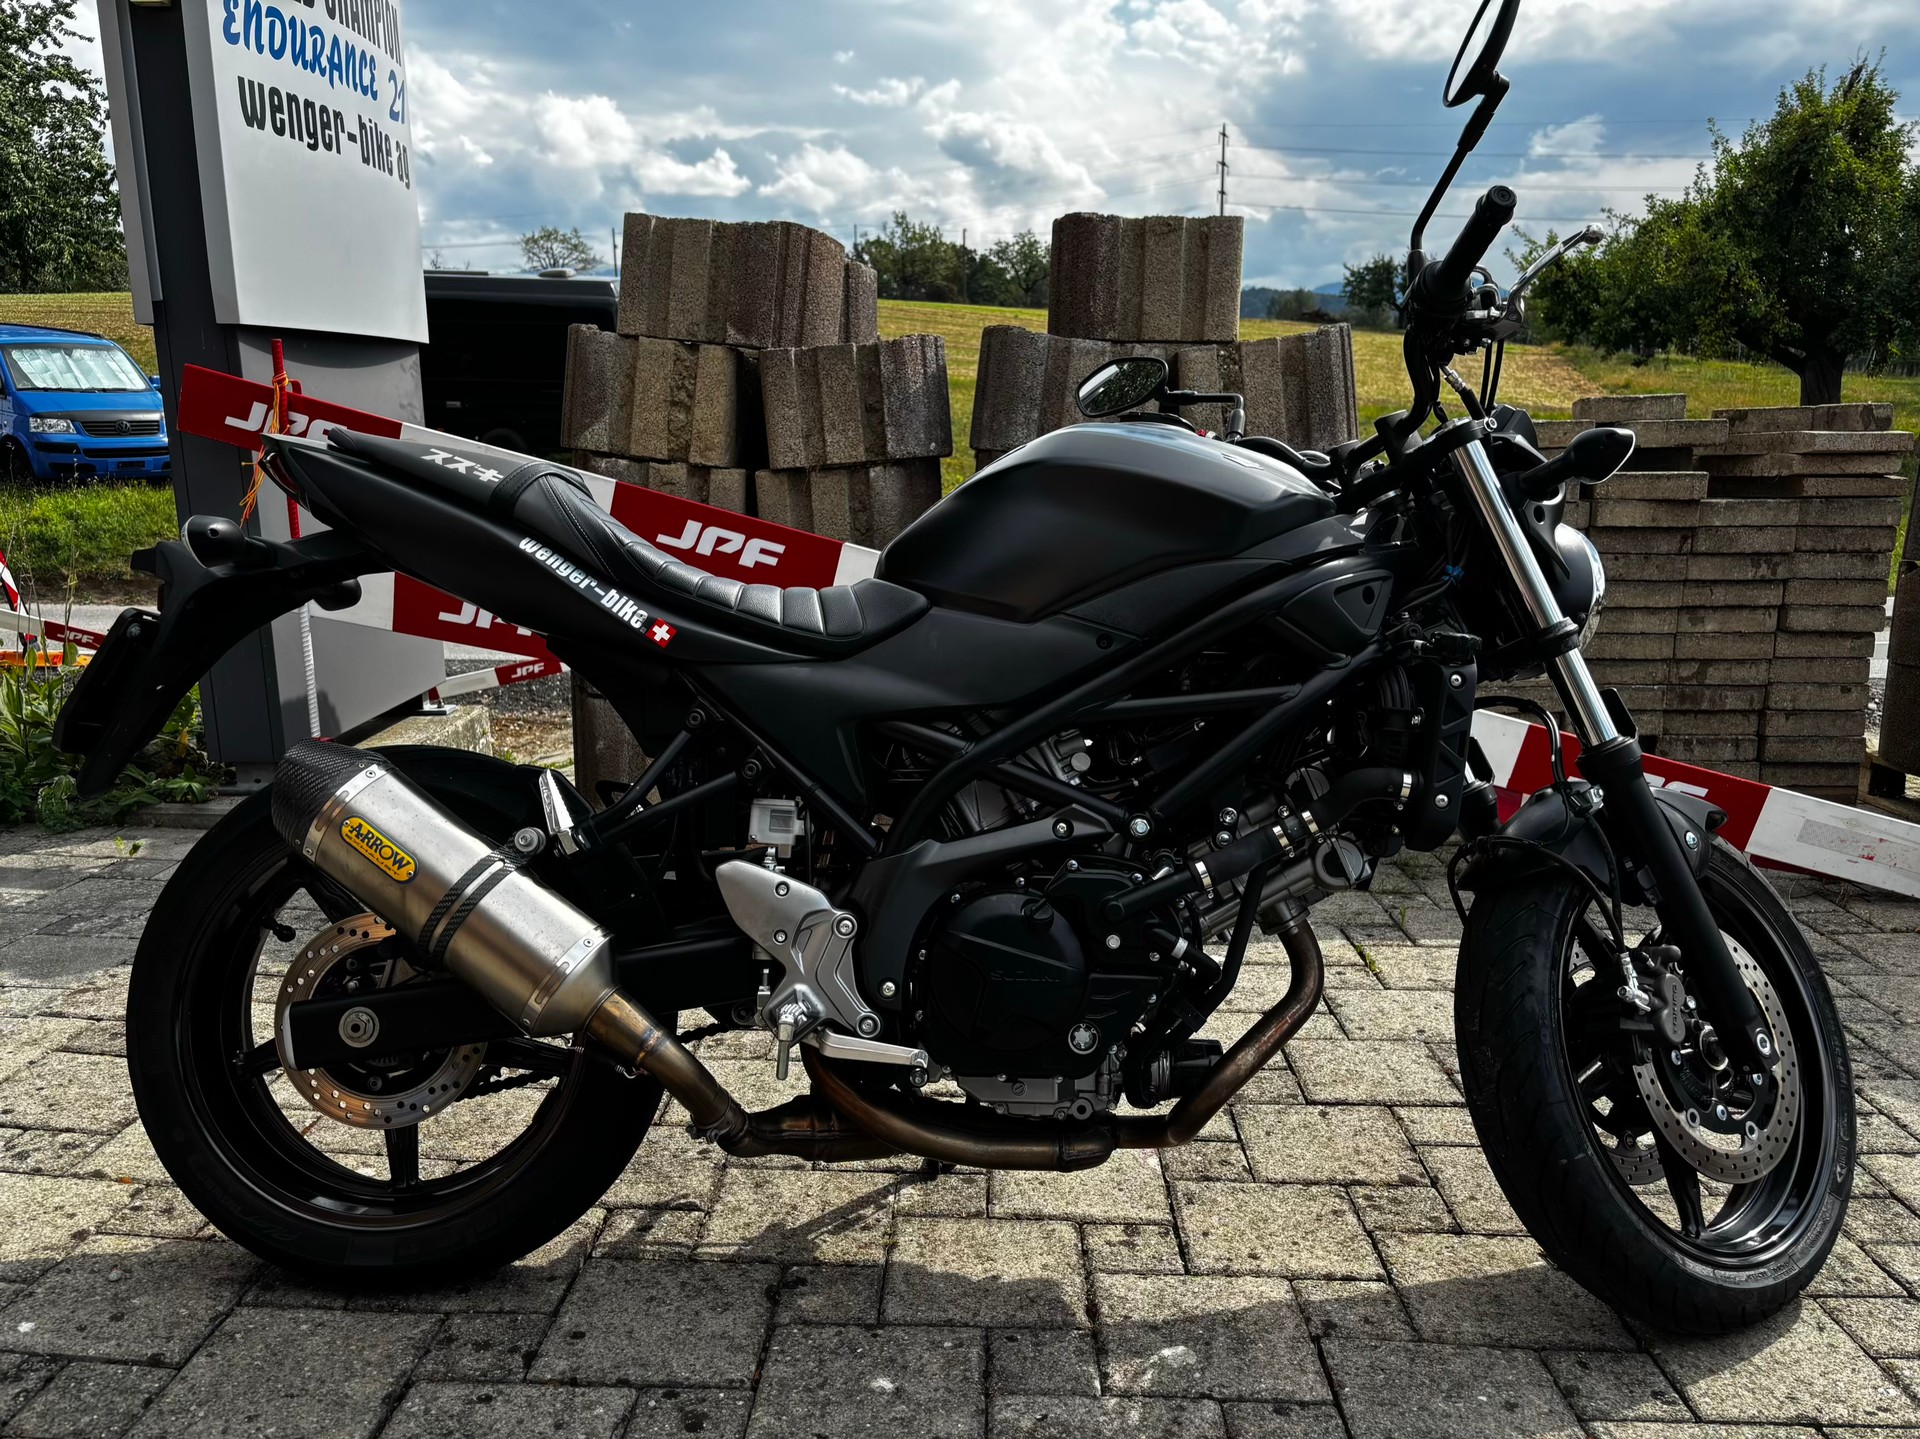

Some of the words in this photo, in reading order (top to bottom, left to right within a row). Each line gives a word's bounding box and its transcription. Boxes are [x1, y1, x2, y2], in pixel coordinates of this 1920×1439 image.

[222, 0, 378, 101] ENDURANCE
[237, 75, 393, 177] wenger-bike
[396, 140, 411, 190] ag
[420, 448, 504, 482] スズキ
[656, 519, 786, 568] JPF
[511, 662, 545, 678] JPF
[347, 822, 412, 871] ARROW
